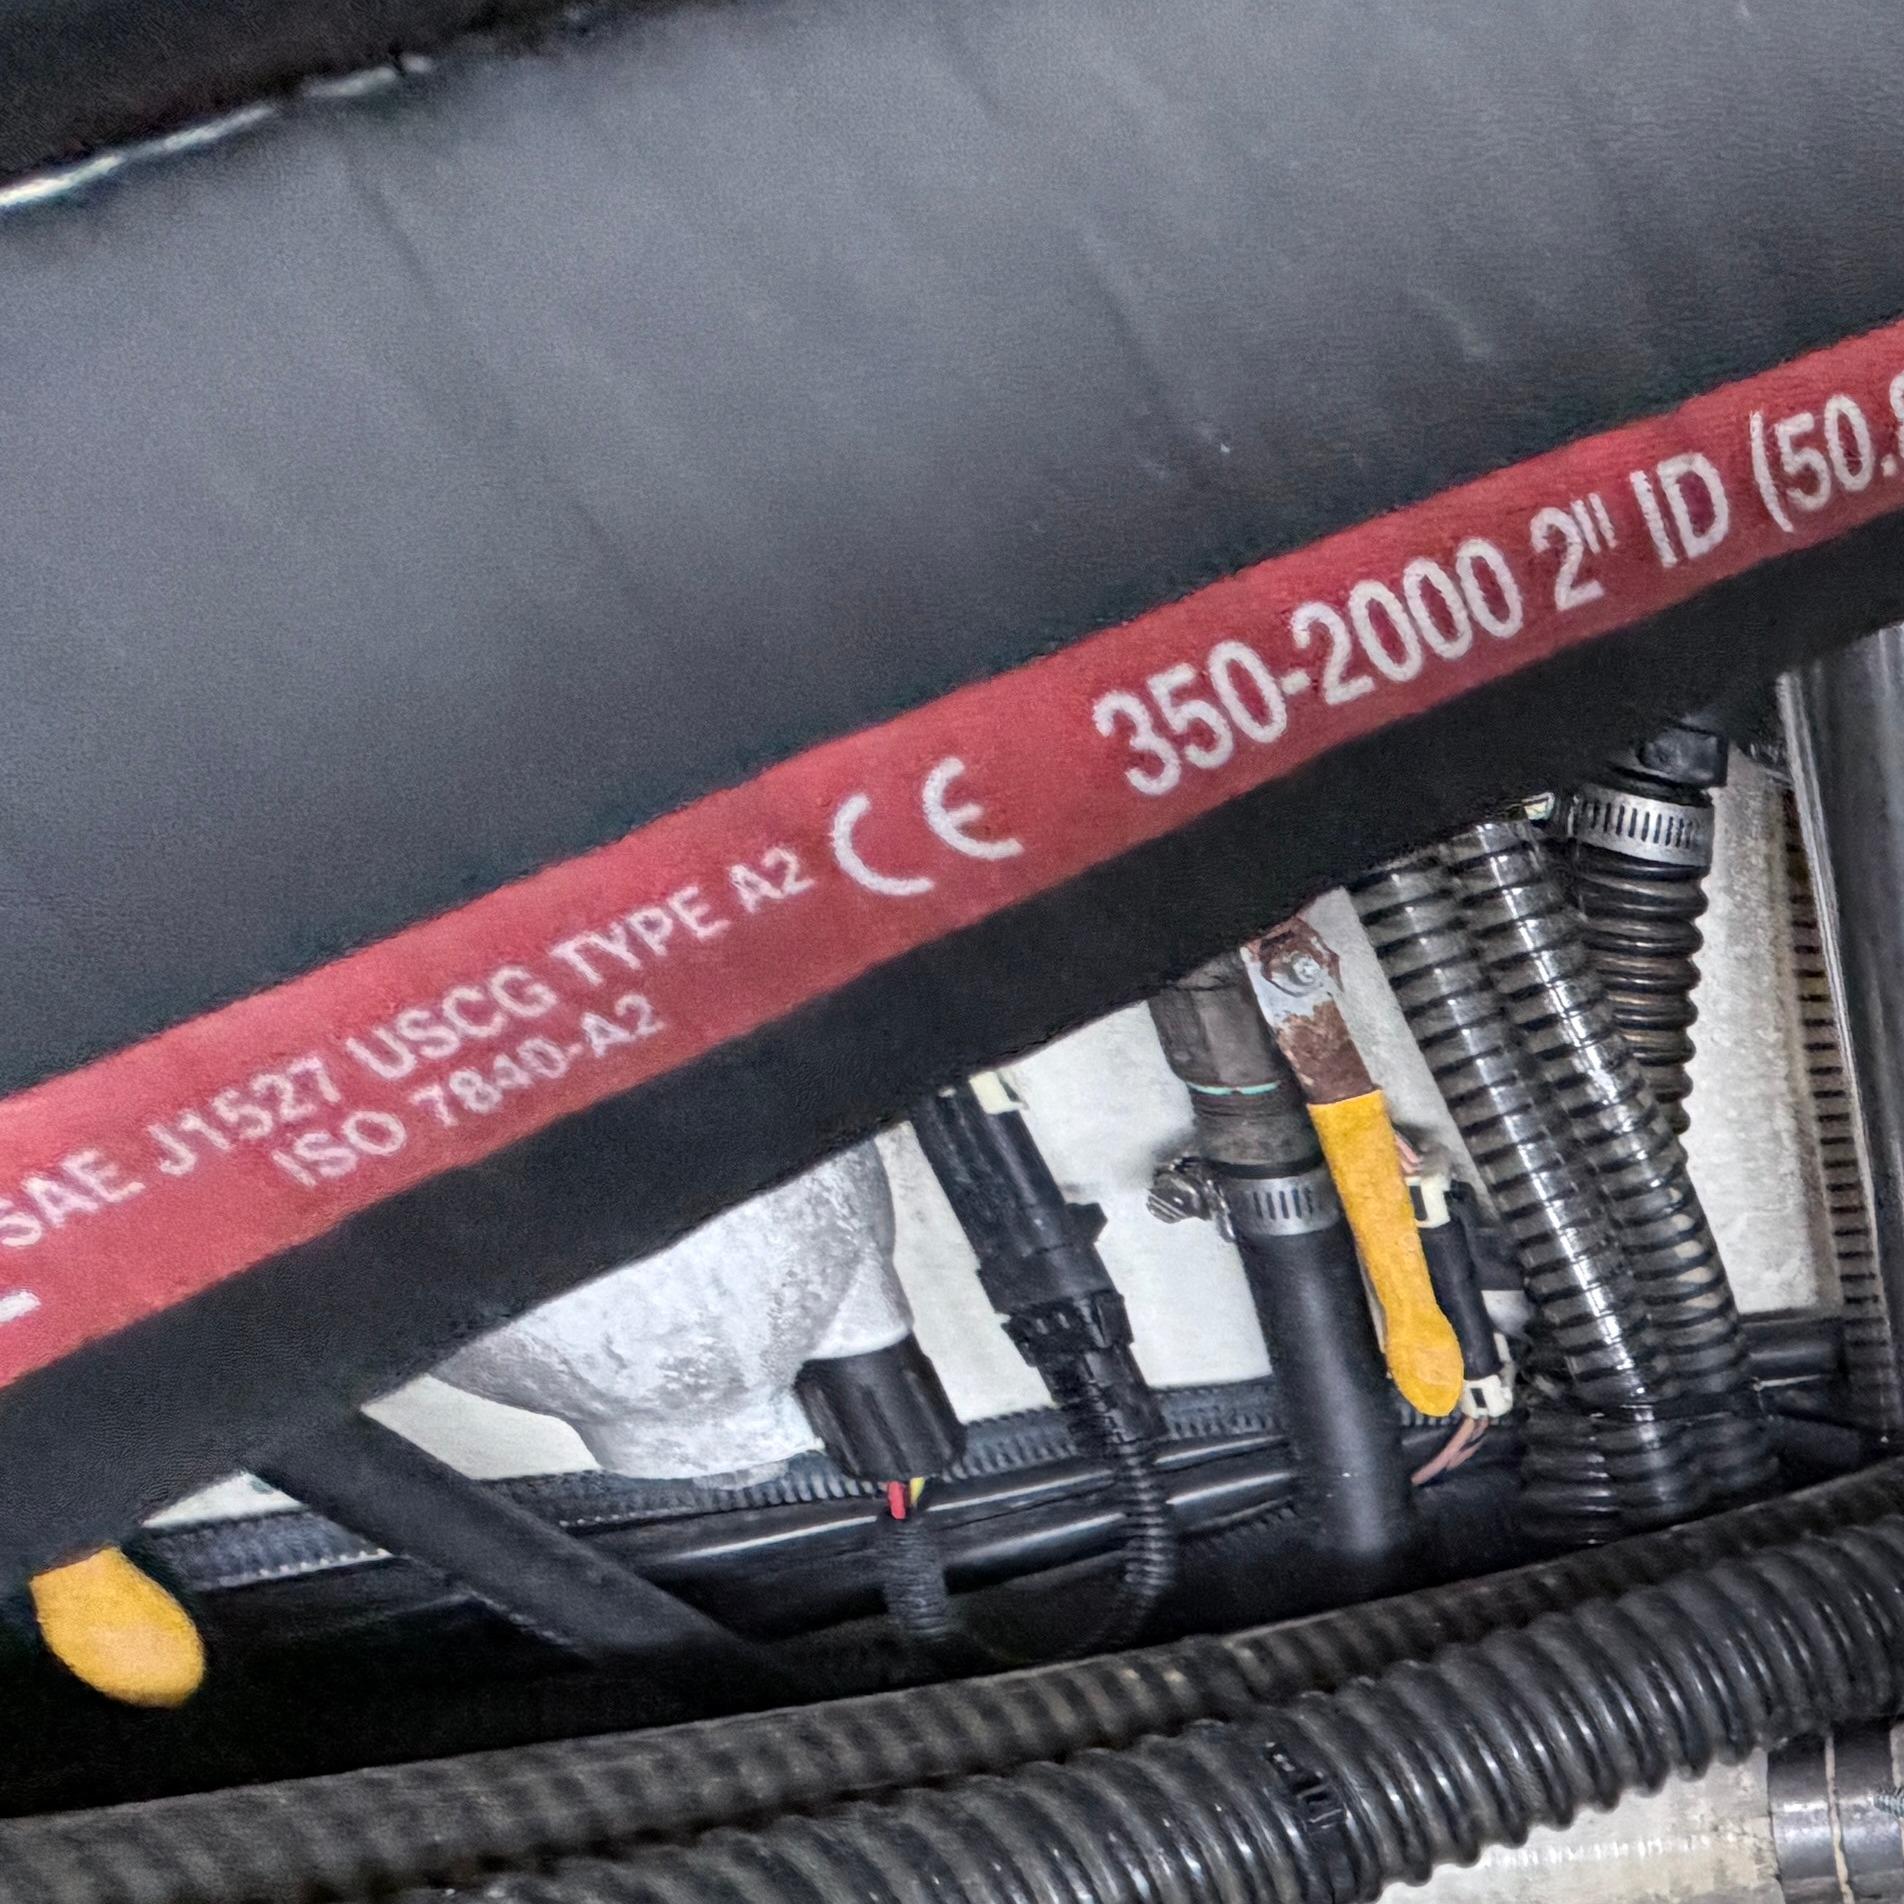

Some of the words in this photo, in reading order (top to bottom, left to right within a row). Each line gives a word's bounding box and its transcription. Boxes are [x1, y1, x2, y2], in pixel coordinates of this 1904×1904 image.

[1090, 538, 1526, 798] 350-2000
[1527, 492, 1617, 614] 2"
[1629, 451, 1729, 568] ID
[152, 1061, 341, 1176] J1527
[344, 962, 560, 1085] USCG
[550, 884, 731, 987] TYPE
[730, 844, 818, 916] A2
[828, 756, 1025, 899] CE
[271, 1108, 407, 1189] ISO
[424, 990, 665, 1130] 7840-A2
